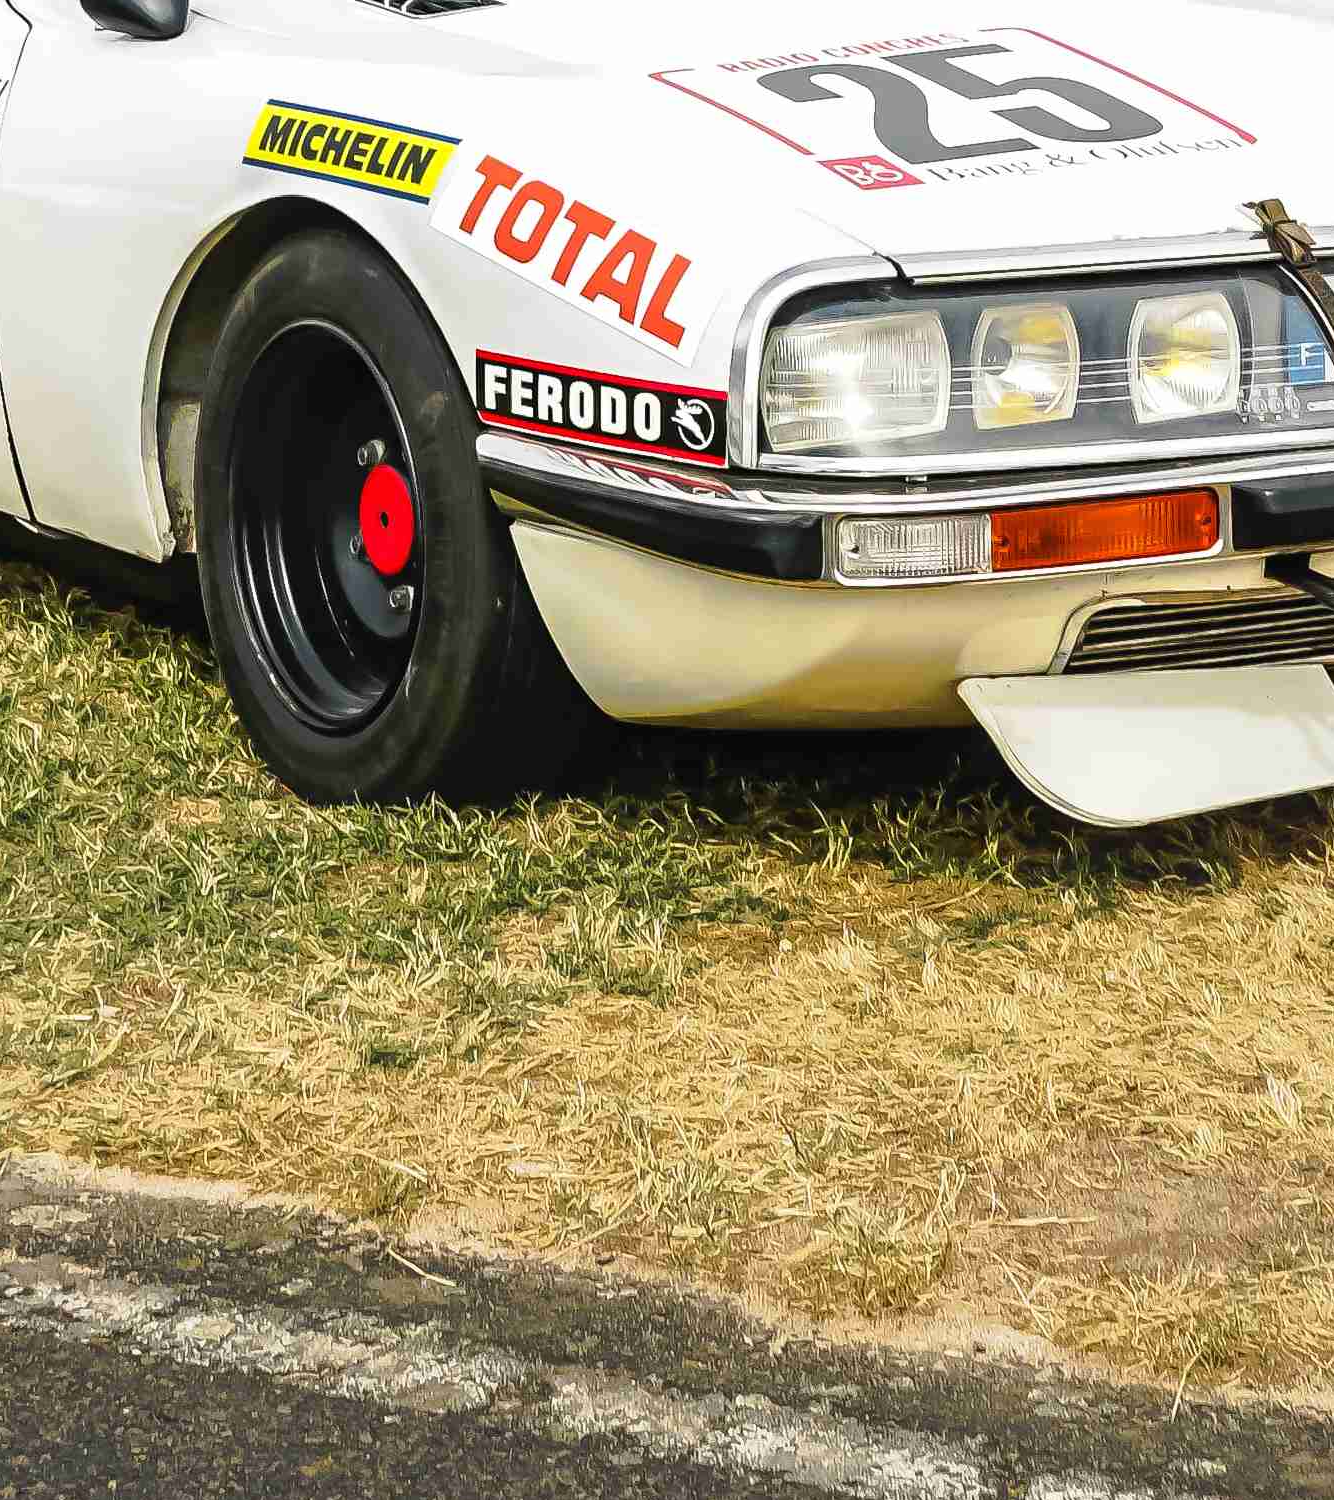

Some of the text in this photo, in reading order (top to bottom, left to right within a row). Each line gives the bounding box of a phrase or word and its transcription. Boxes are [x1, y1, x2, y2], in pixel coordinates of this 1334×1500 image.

[755, 42, 1164, 166] 25
[258, 114, 439, 186] MICHELIN
[458, 153, 692, 351] TOTAL
[1300, 342, 1312, 367] F
[483, 361, 662, 442] FERODO
